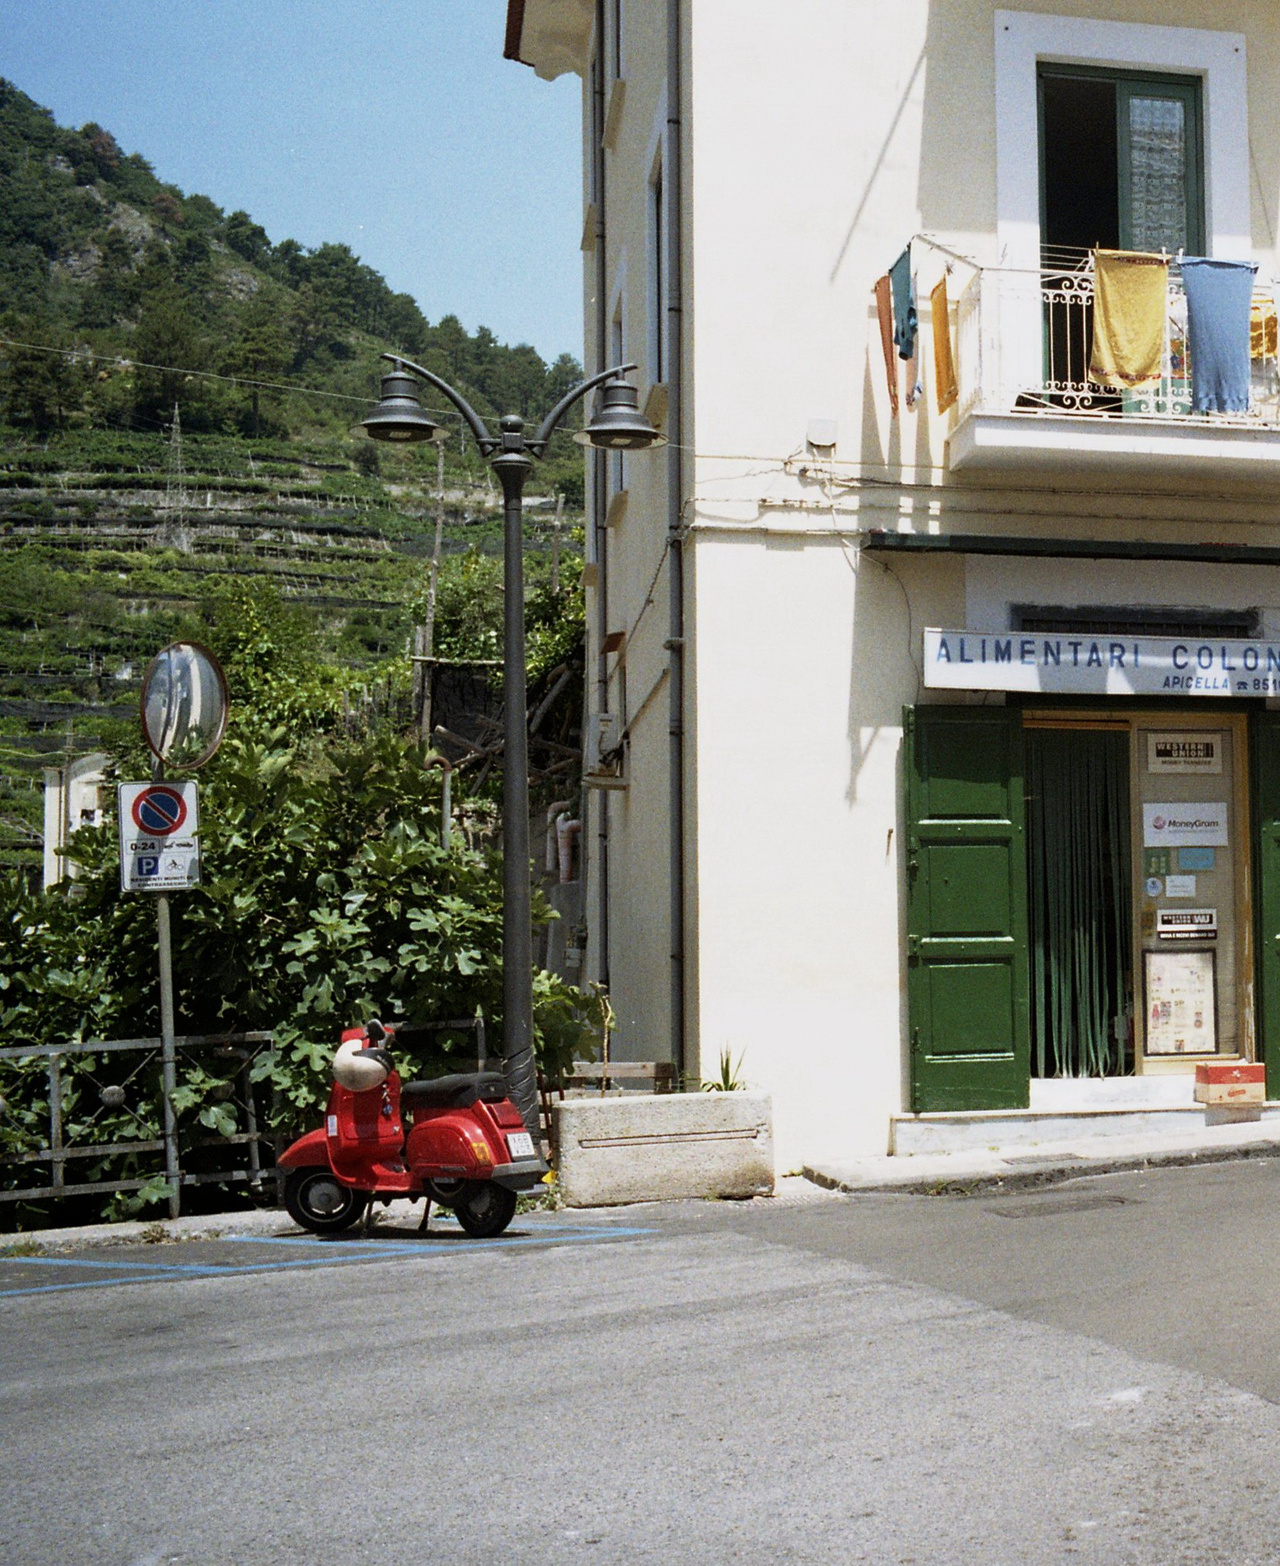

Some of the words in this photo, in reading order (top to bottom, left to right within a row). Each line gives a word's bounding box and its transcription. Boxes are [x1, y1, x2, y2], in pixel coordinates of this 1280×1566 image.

[936, 637, 1140, 668] ALIMENTARI
[1162, 675, 1229, 690] APICELLA
[1167, 819, 1219, 830] MoneyGram
[130, 842, 156, 851] 0-24
[142, 858, 155, 875] P
